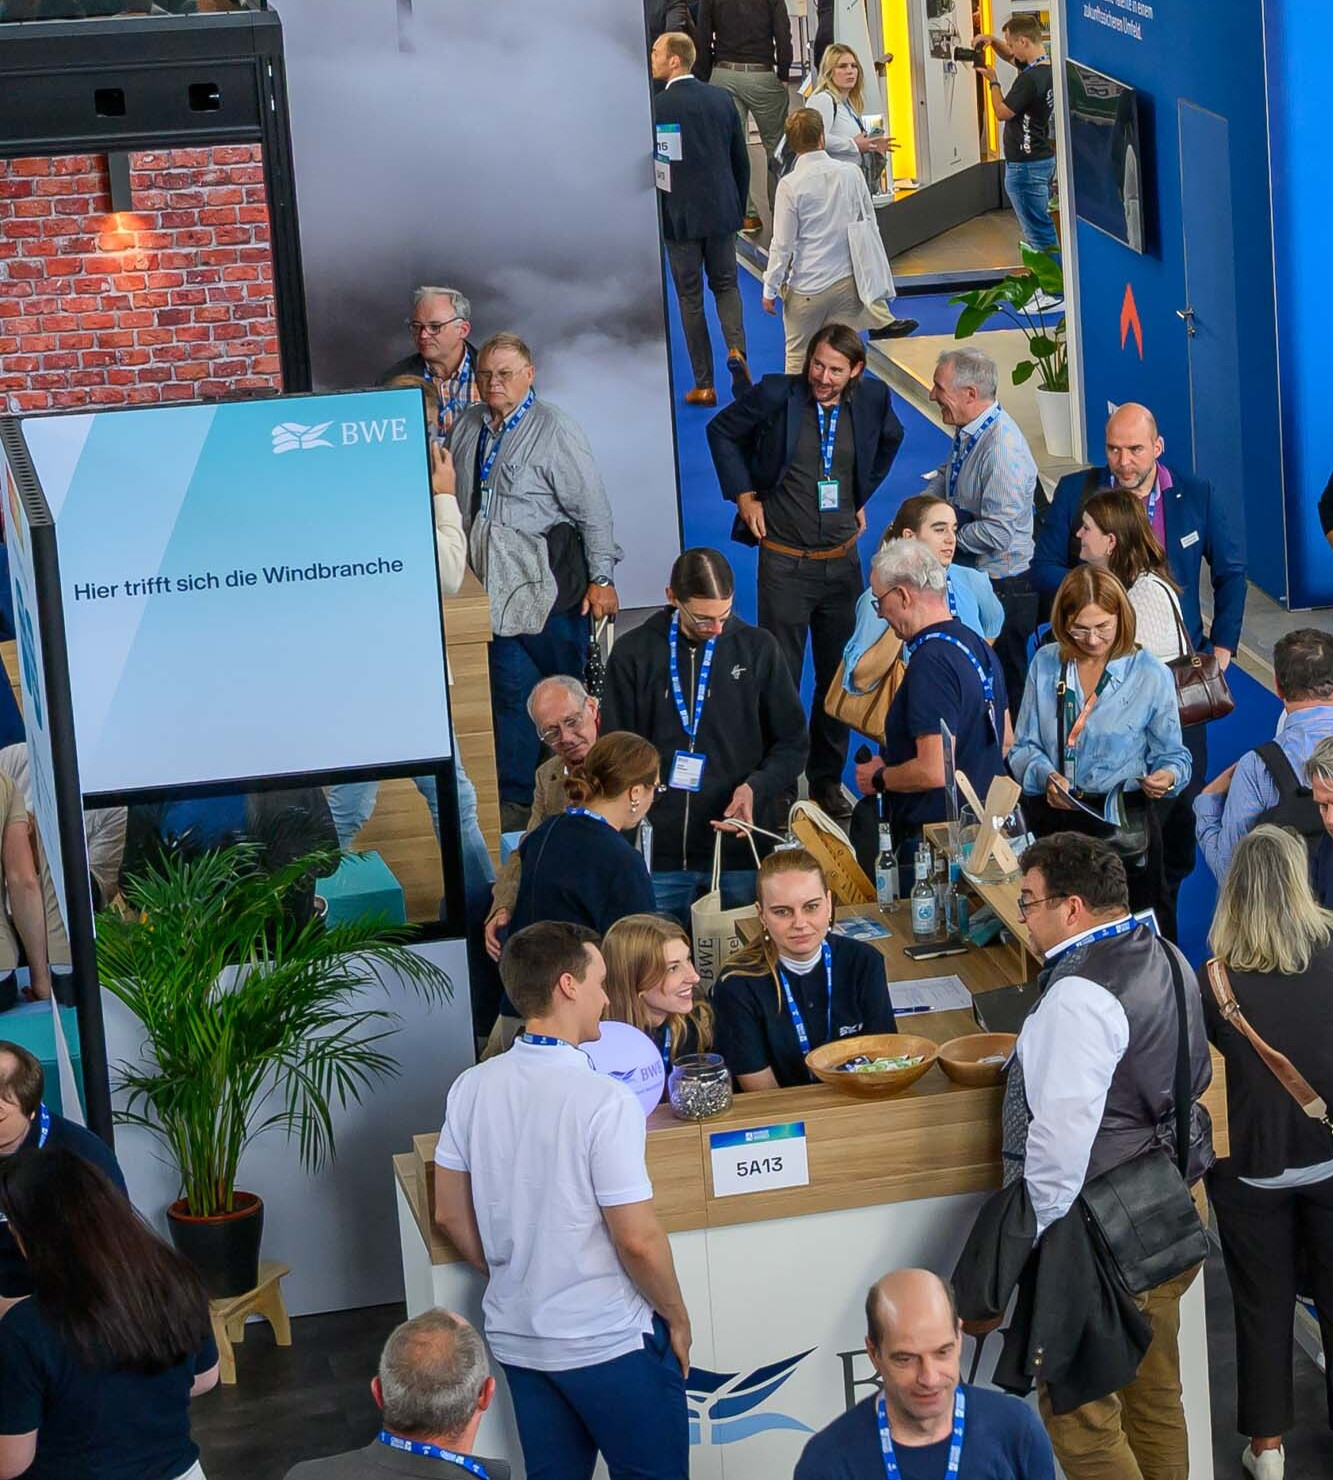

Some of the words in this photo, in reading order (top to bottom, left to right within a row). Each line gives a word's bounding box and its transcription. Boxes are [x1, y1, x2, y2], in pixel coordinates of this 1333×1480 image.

[343, 418, 408, 445] BWE
[74, 582, 119, 601] Hier
[123, 576, 172, 598] trifft
[176, 571, 220, 593] sich
[225, 569, 258, 588] die
[262, 557, 404, 584] Windbranche
[698, 937, 714, 980] BWE
[737, 1156, 783, 1177] 5A13
